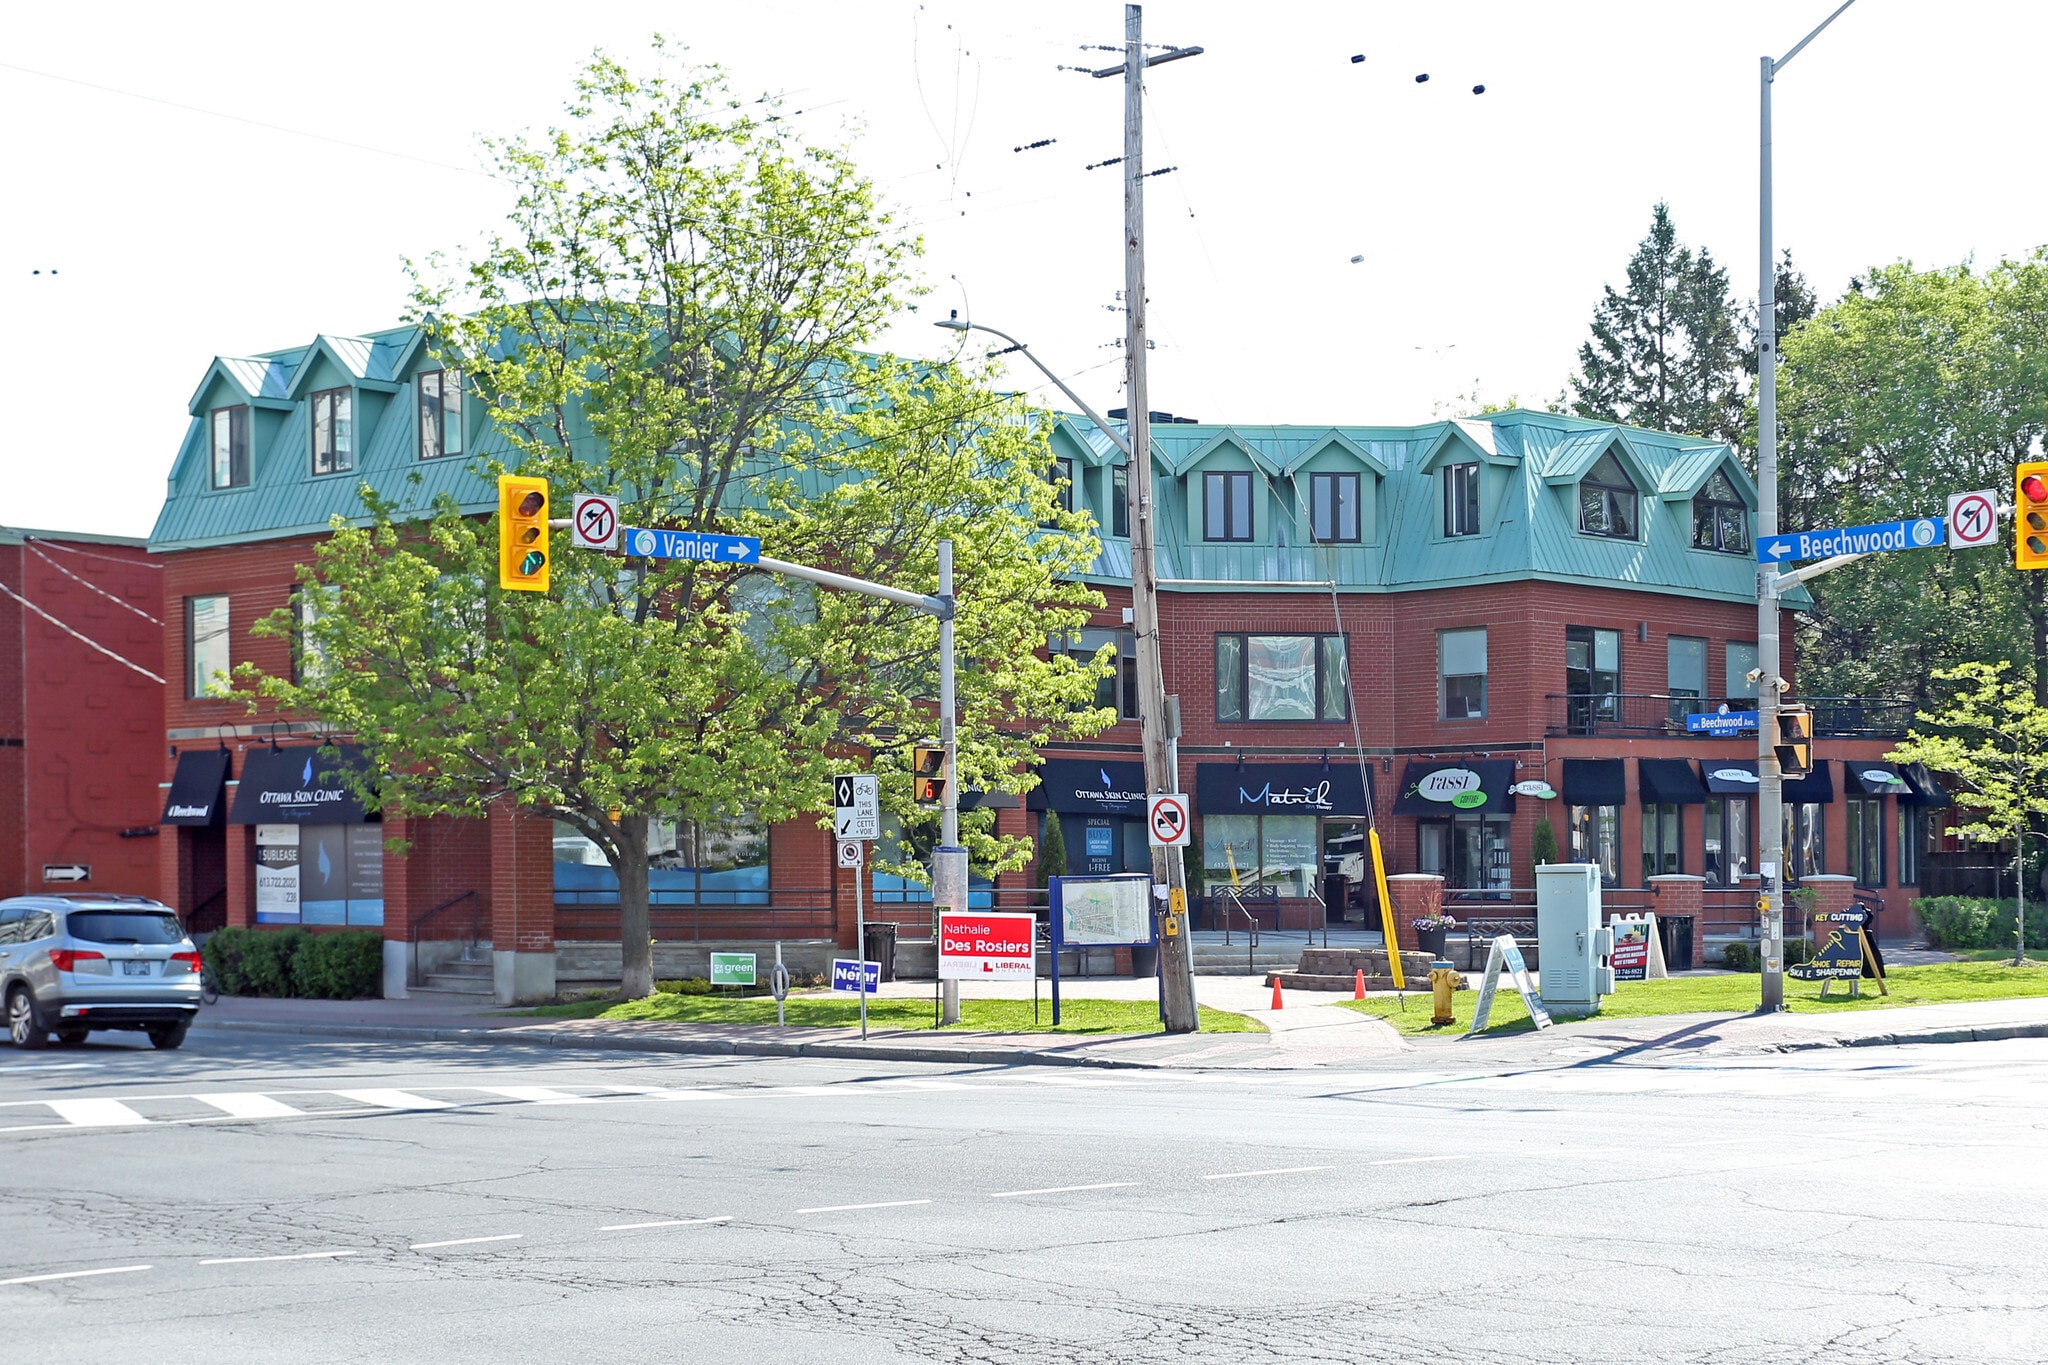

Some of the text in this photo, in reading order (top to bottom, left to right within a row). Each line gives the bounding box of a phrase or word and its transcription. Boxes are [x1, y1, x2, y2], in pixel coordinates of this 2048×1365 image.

[664, 533, 719, 559] Vanier
[1800, 522, 1906, 558] Beechwood
[1701, 714, 1742, 728] Beechwood
[1743, 718, 1755, 726] Ave.
[967, 784, 983, 793] NIC
[1429, 776, 1469, 790] rassi
[260, 789, 345, 804] OTTAWA SKIN CLINIC
[925, 782, 933, 799] 6
[1075, 789, 1146, 801] OTTAWA SKIN CLINIC
[173, 804, 209, 817] Beechwood
[856, 820, 875, 828] CETTE
[1088, 818, 1110, 826] SPECIAL
[262, 849, 297, 861] SUBLEASE
[1088, 863, 1111, 872] 1-FREE
[259, 877, 297, 888] 613.722.2020
[1814, 913, 1864, 922] KEY CUTTING
[944, 924, 991, 935] Nathalie
[944, 938, 1029, 953] Des Rosiers
[725, 963, 754, 975] green
[995, 962, 1032, 970] LIBERAL
[1811, 959, 1862, 968] SHOE REPAIR
[835, 967, 877, 984] Nemr
[1815, 968, 1861, 977] SHARPENING
